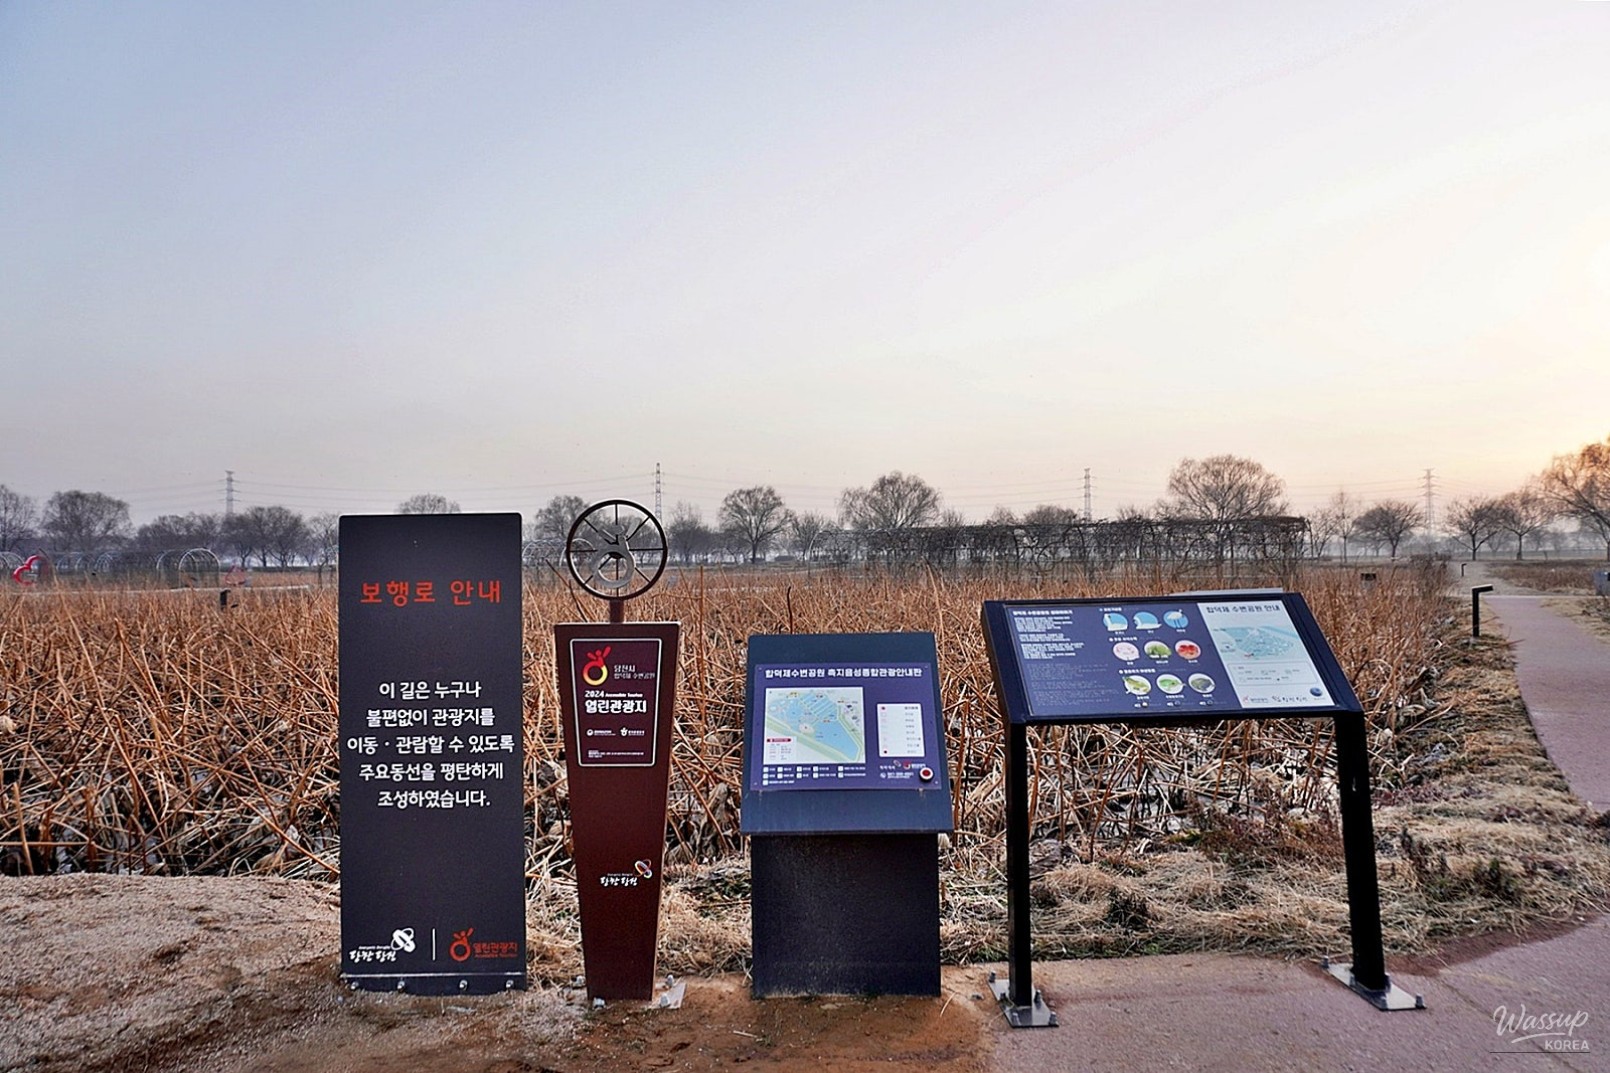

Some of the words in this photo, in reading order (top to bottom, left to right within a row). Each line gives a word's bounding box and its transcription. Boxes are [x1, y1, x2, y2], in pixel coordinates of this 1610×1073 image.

[360, 580, 436, 607] 보행로
[450, 580, 501, 606] 안내
[1206, 606, 1230, 614] 합덕제
[1231, 605, 1263, 613] 수변공원
[1264, 604, 1281, 612] 안내
[765, 668, 825, 678] 합덕제수변공원
[379, 682, 395, 699] 이
[400, 681, 431, 700] 길은
[434, 681, 482, 699] 누구나
[584, 690, 605, 698] 2024
[585, 699, 647, 714] 열린관광지
[366, 709, 428, 728] 불편없이
[432, 708, 495, 727] 관광지를
[347, 737, 379, 755] 이동
[396, 736, 445, 755] 관람할
[448, 736, 465, 753] 수
[468, 735, 515, 753] 있도록
[359, 763, 436, 782] 주요동선을
[440, 762, 504, 782] 평탄하게
[378, 790, 491, 810] 조성하였습니다.
[473, 942, 518, 953] 열린관광지
